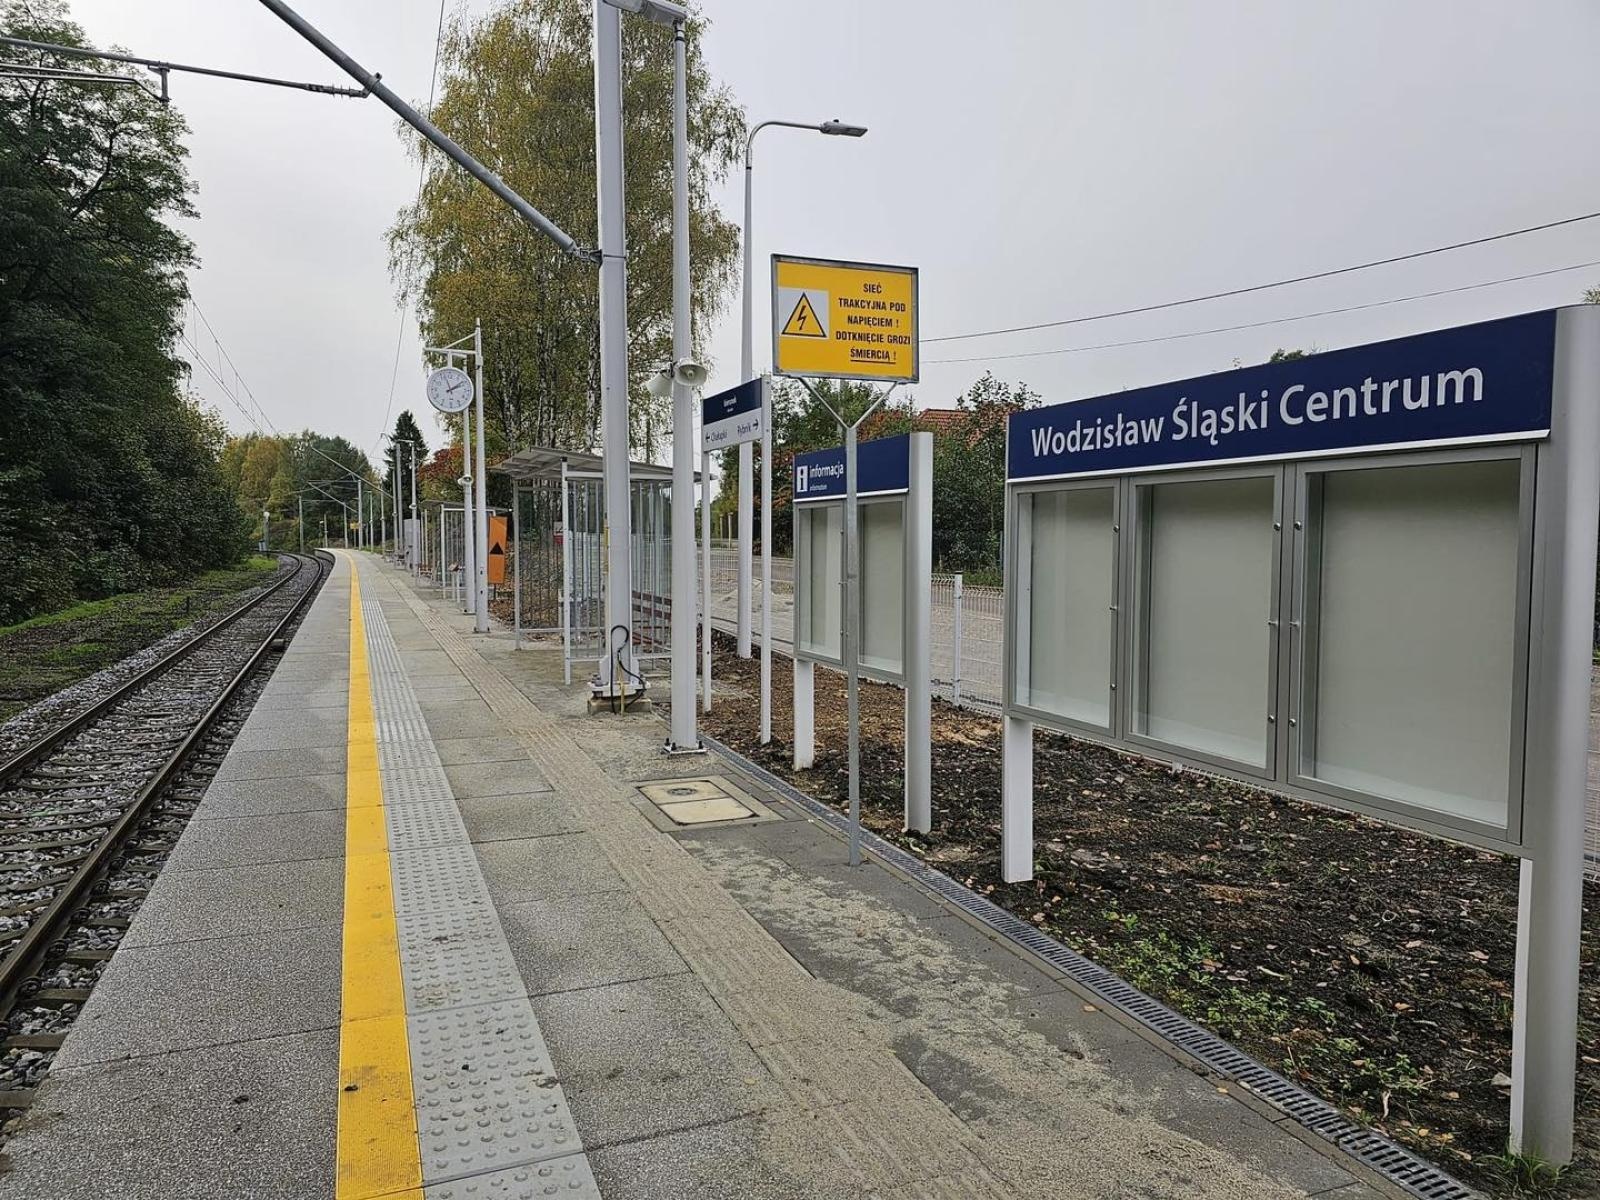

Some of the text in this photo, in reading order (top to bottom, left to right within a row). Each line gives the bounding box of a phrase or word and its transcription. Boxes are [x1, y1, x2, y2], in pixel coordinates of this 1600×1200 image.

[863, 281, 882, 294] SIEĆ
[838, 298, 906, 312] TRAKCYJNA POD
[847, 315, 893, 328] NAPIĘCIEM
[836, 330, 910, 345] DOTKNIĘCIE GROZI
[850, 346, 890, 361] ŚMIERCIĄ
[1031, 366, 1484, 457] Wodzisław Śląski Centrum
[810, 460, 844, 479] informacja
